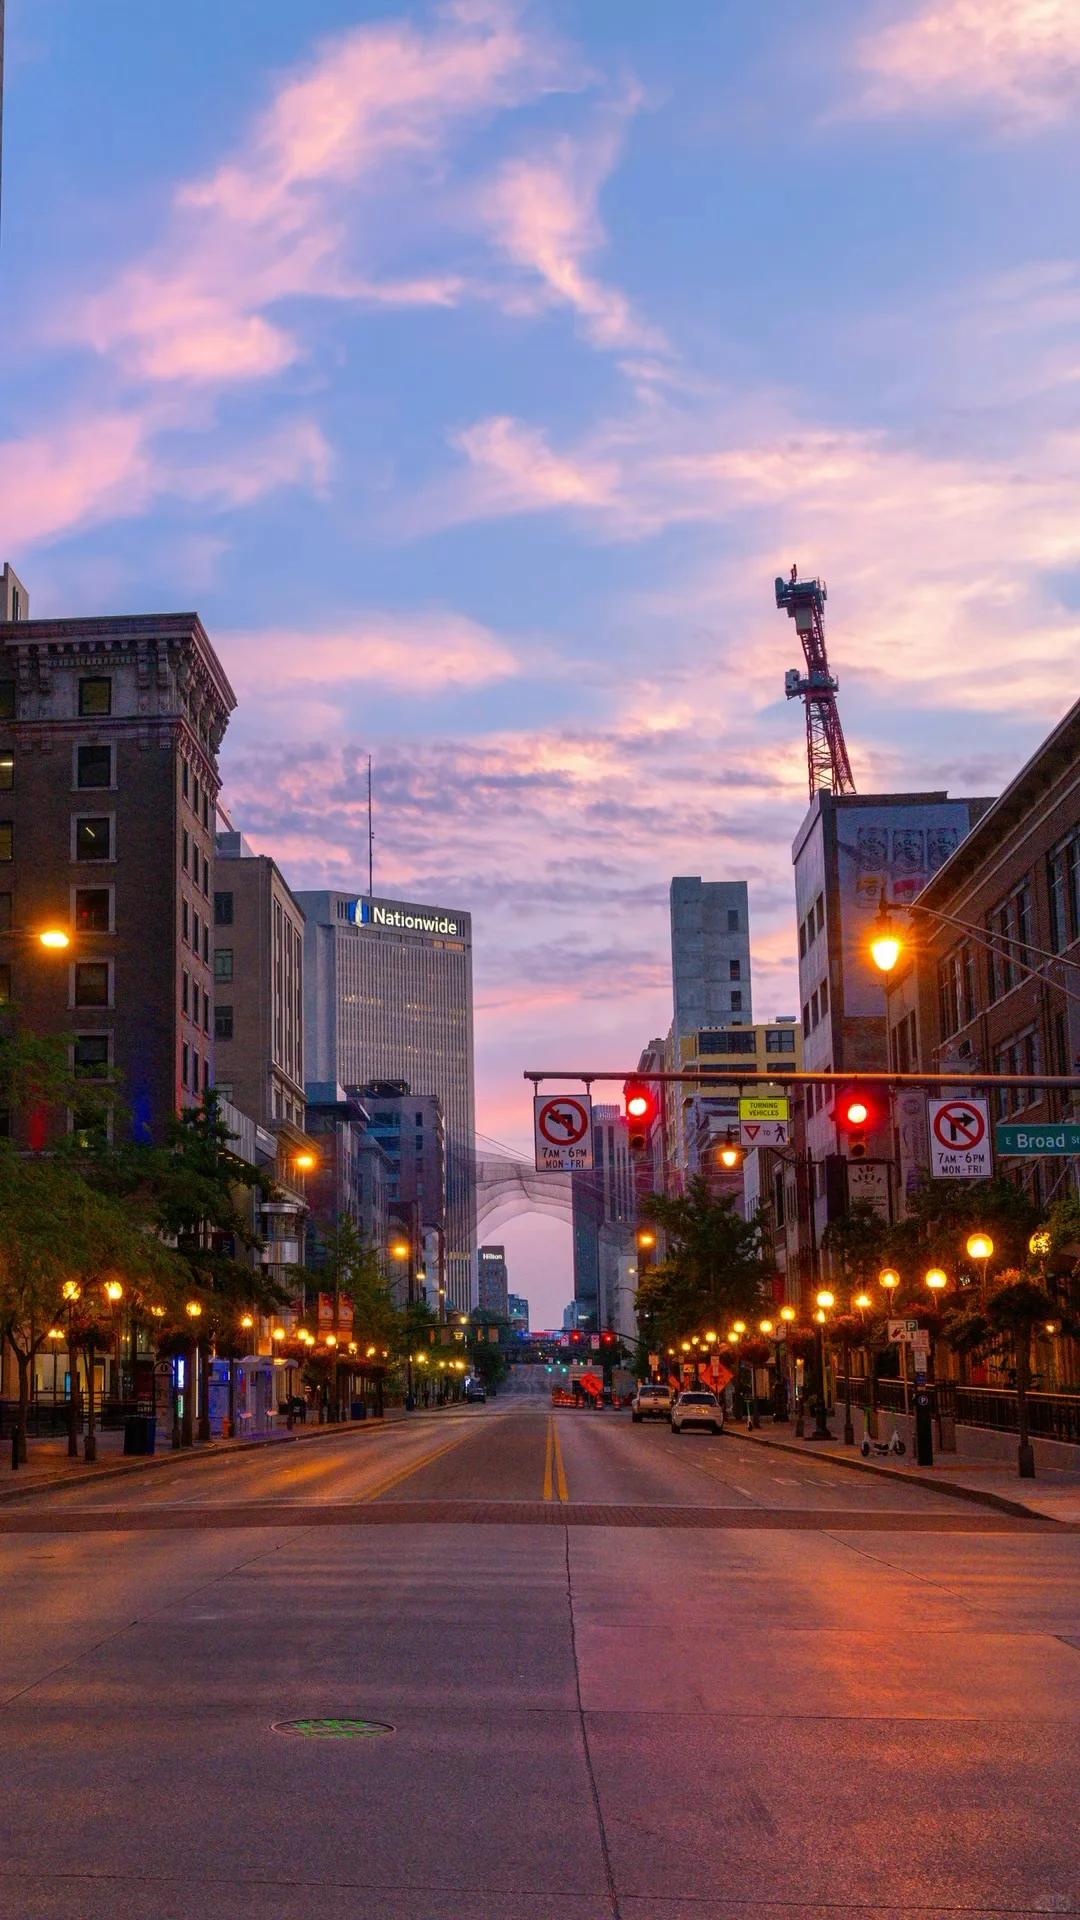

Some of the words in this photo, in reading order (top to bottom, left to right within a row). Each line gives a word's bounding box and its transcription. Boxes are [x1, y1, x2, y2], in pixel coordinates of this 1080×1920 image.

[373, 906, 457, 934] Nationwide
[1005, 1136, 1012, 1145] E
[1017, 1133, 1065, 1148] Broad
[908, 1322, 915, 1331] P
